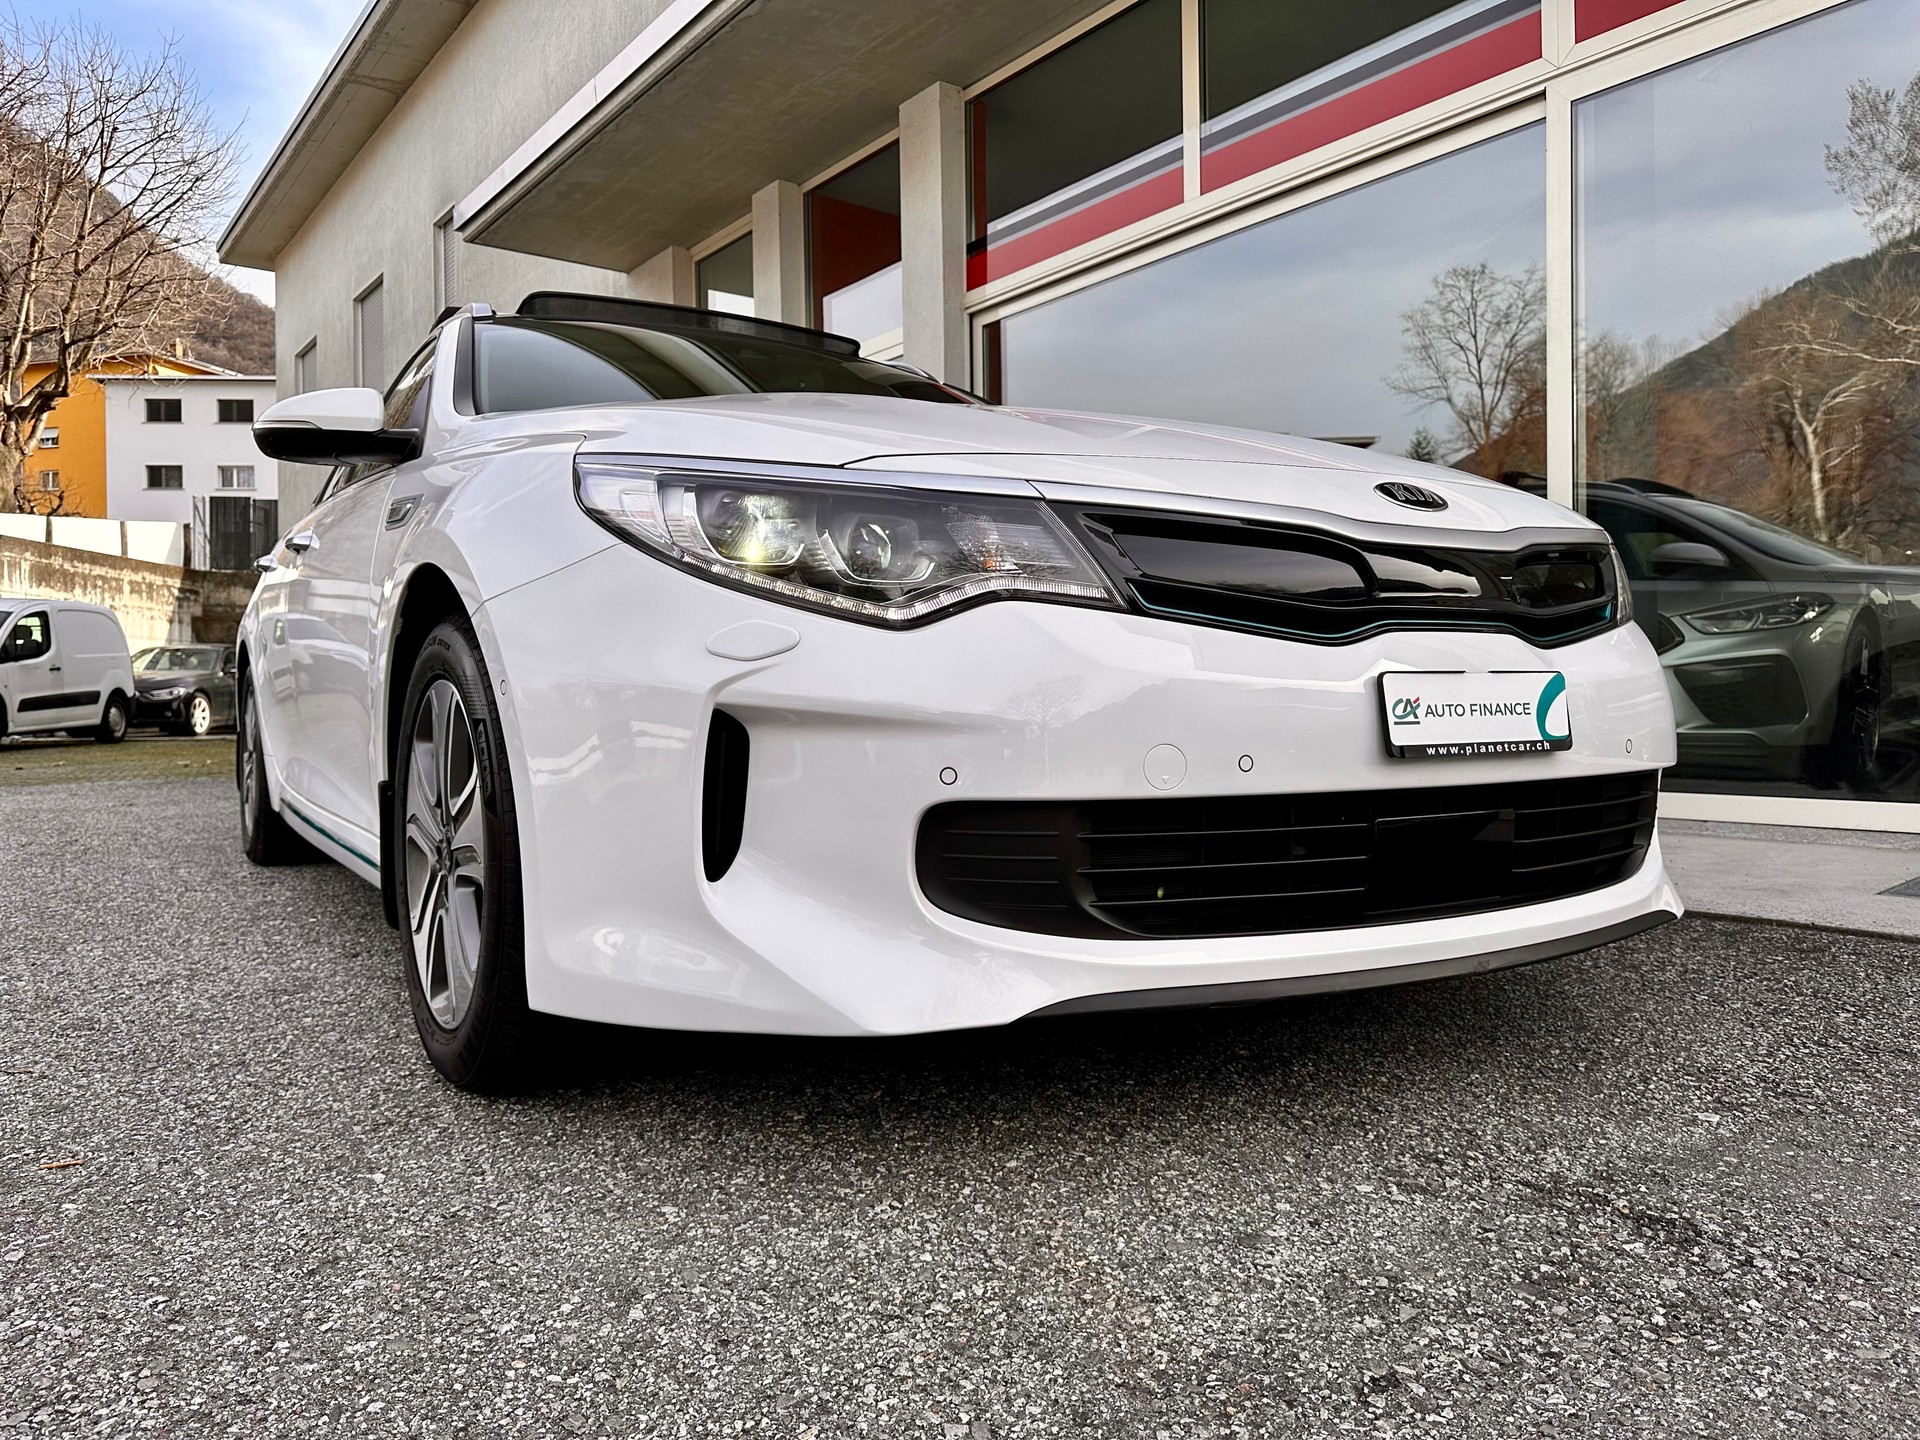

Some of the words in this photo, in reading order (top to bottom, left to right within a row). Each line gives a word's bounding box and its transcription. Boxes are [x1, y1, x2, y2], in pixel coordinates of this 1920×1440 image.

[1384, 484, 1443, 504] KIA
[1425, 703, 1465, 718] AUTO
[1470, 702, 1531, 717] FINANCE
[1426, 740, 1551, 756] www.planetcar.ch
